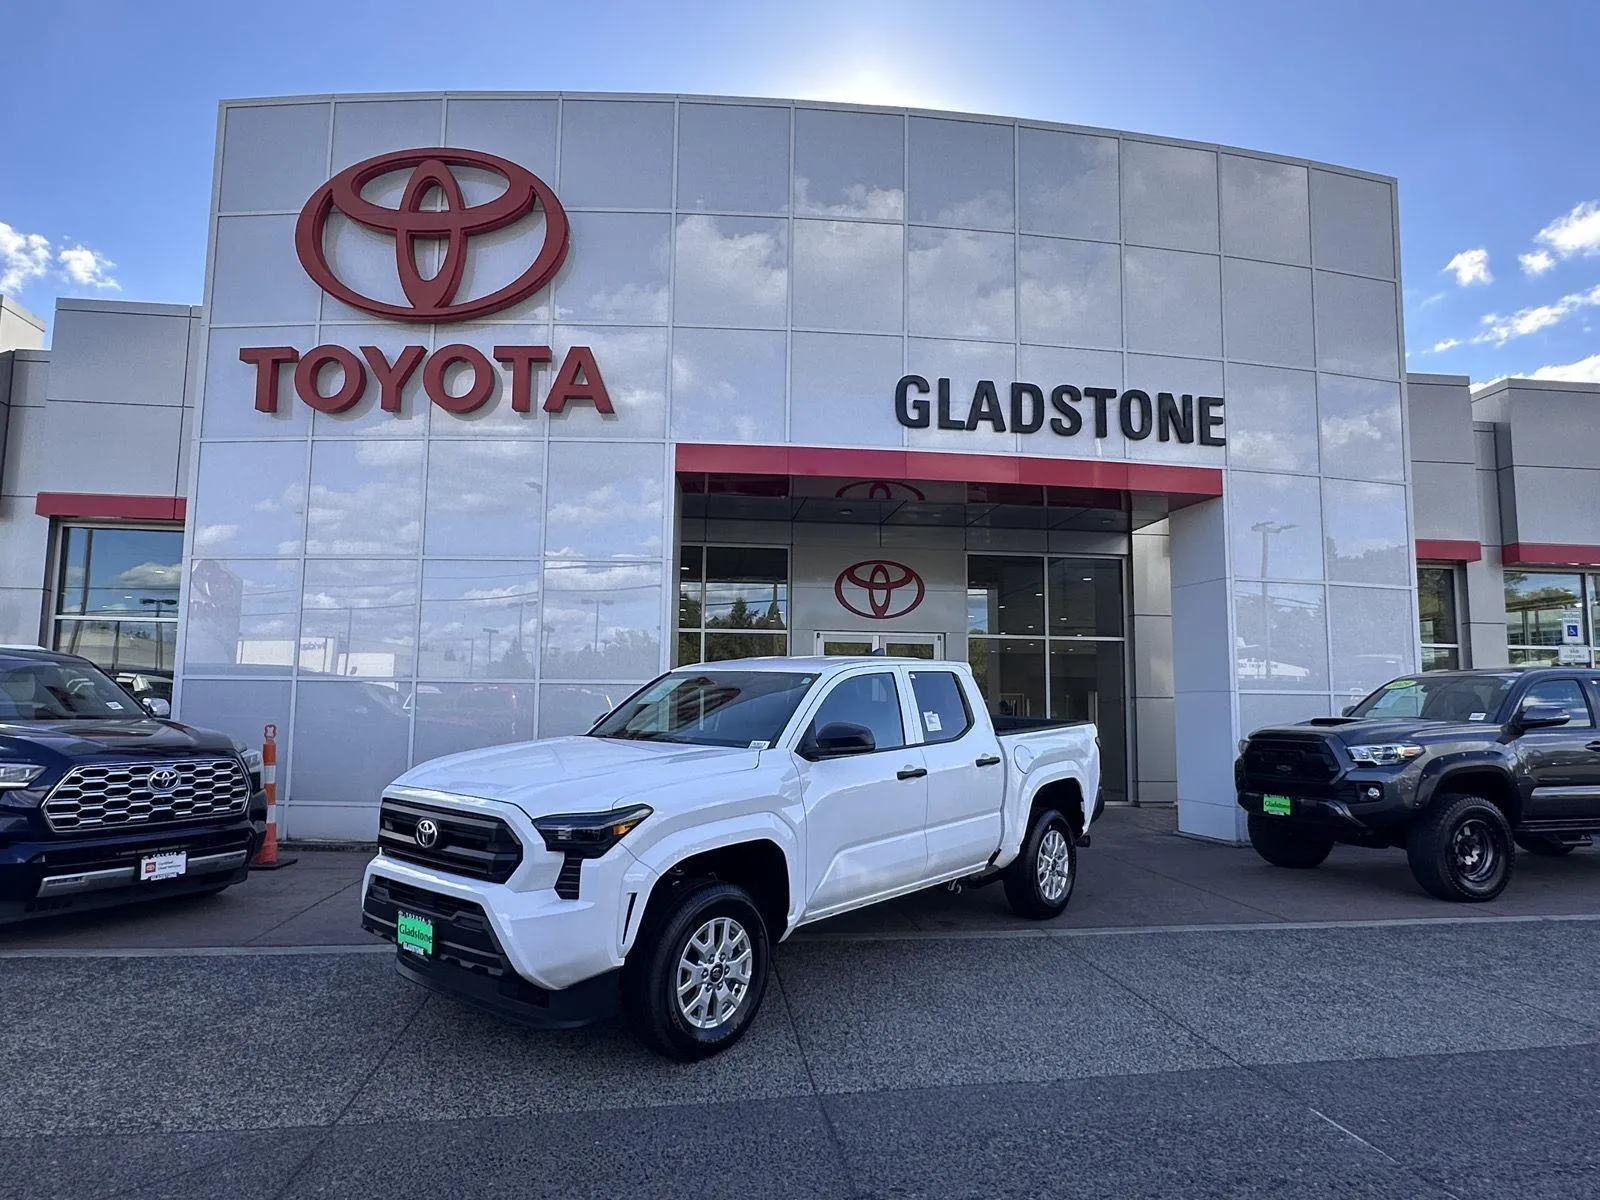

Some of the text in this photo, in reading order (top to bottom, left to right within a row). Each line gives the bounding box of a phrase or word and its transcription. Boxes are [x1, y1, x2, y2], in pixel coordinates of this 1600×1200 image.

[240, 344, 614, 413] TOYOTA
[895, 375, 1225, 446] GLADSTONE
[399, 923, 432, 943] Gladstone
